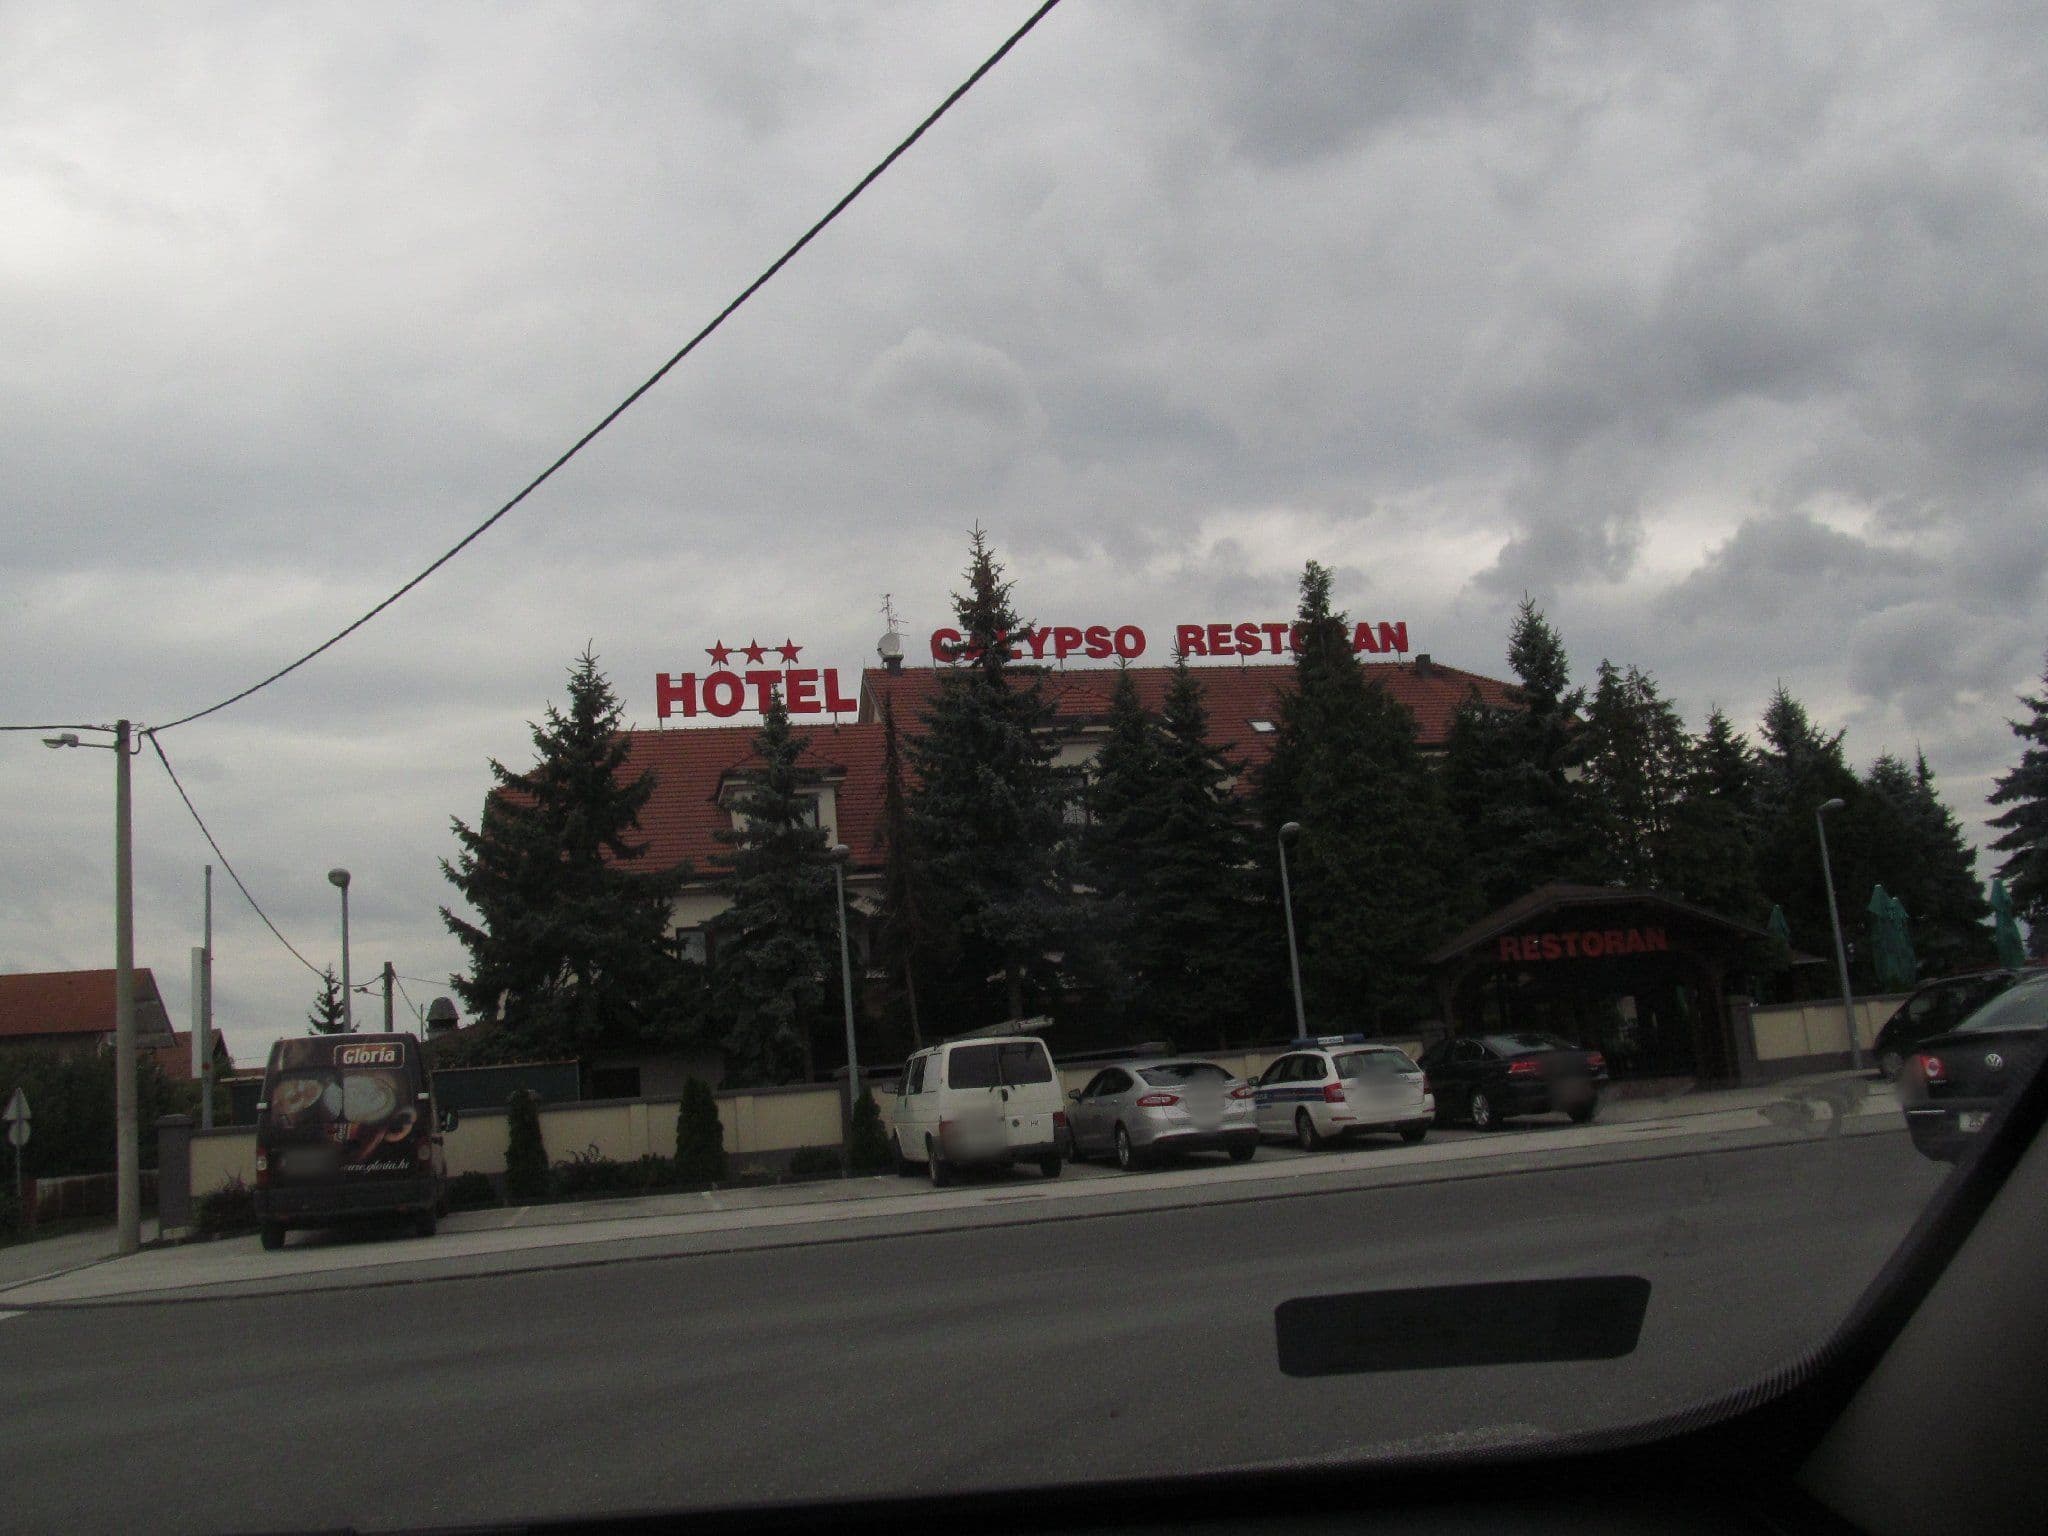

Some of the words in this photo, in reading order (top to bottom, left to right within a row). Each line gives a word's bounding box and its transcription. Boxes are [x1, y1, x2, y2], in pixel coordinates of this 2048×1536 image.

[1176, 621, 1409, 657] RESTOAN
[656, 668, 858, 717] HOTEL
[1497, 927, 1670, 961] RESTORAN
[343, 1047, 396, 1065] Gloria
